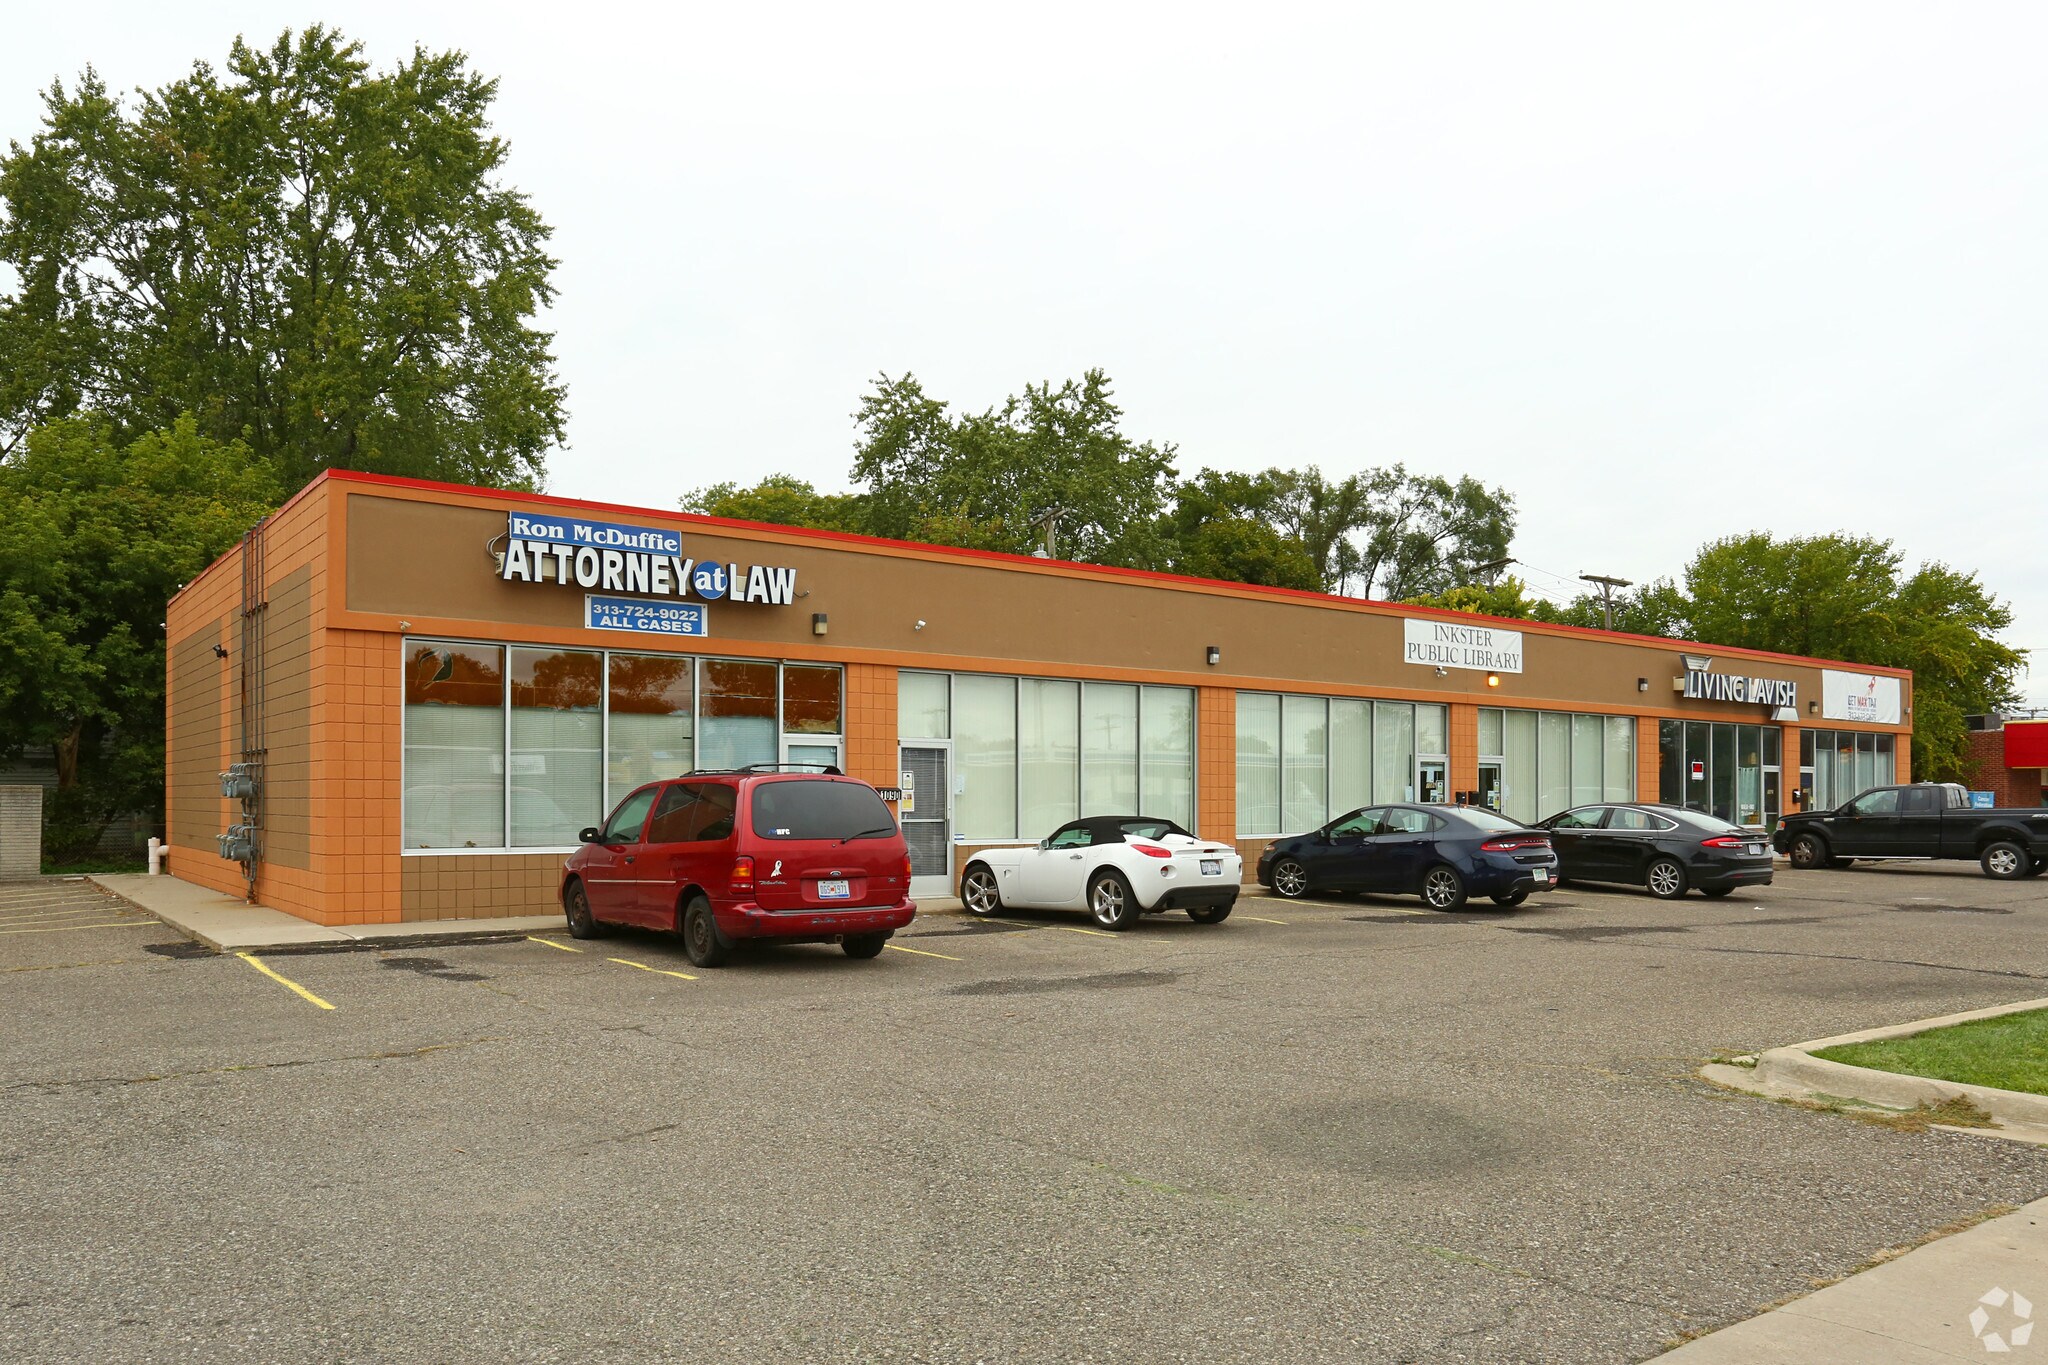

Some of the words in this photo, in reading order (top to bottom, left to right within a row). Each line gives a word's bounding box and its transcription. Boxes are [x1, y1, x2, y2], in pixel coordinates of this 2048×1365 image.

[512, 517, 565, 539] Ron
[573, 525, 679, 552] McDuffie
[503, 540, 694, 596] ATTORNEY
[694, 566, 728, 593] at
[729, 563, 797, 605] LAW
[593, 603, 699, 621] 313-724-9022
[600, 614, 634, 628] ALL
[641, 619, 693, 633] CASES
[1434, 624, 1493, 647] INKSTER
[1408, 642, 1459, 664] PUBLIC
[1464, 648, 1520, 670] LIBRARY
[1686, 671, 1744, 702] LIVING
[1748, 677, 1796, 706] LAVISH
